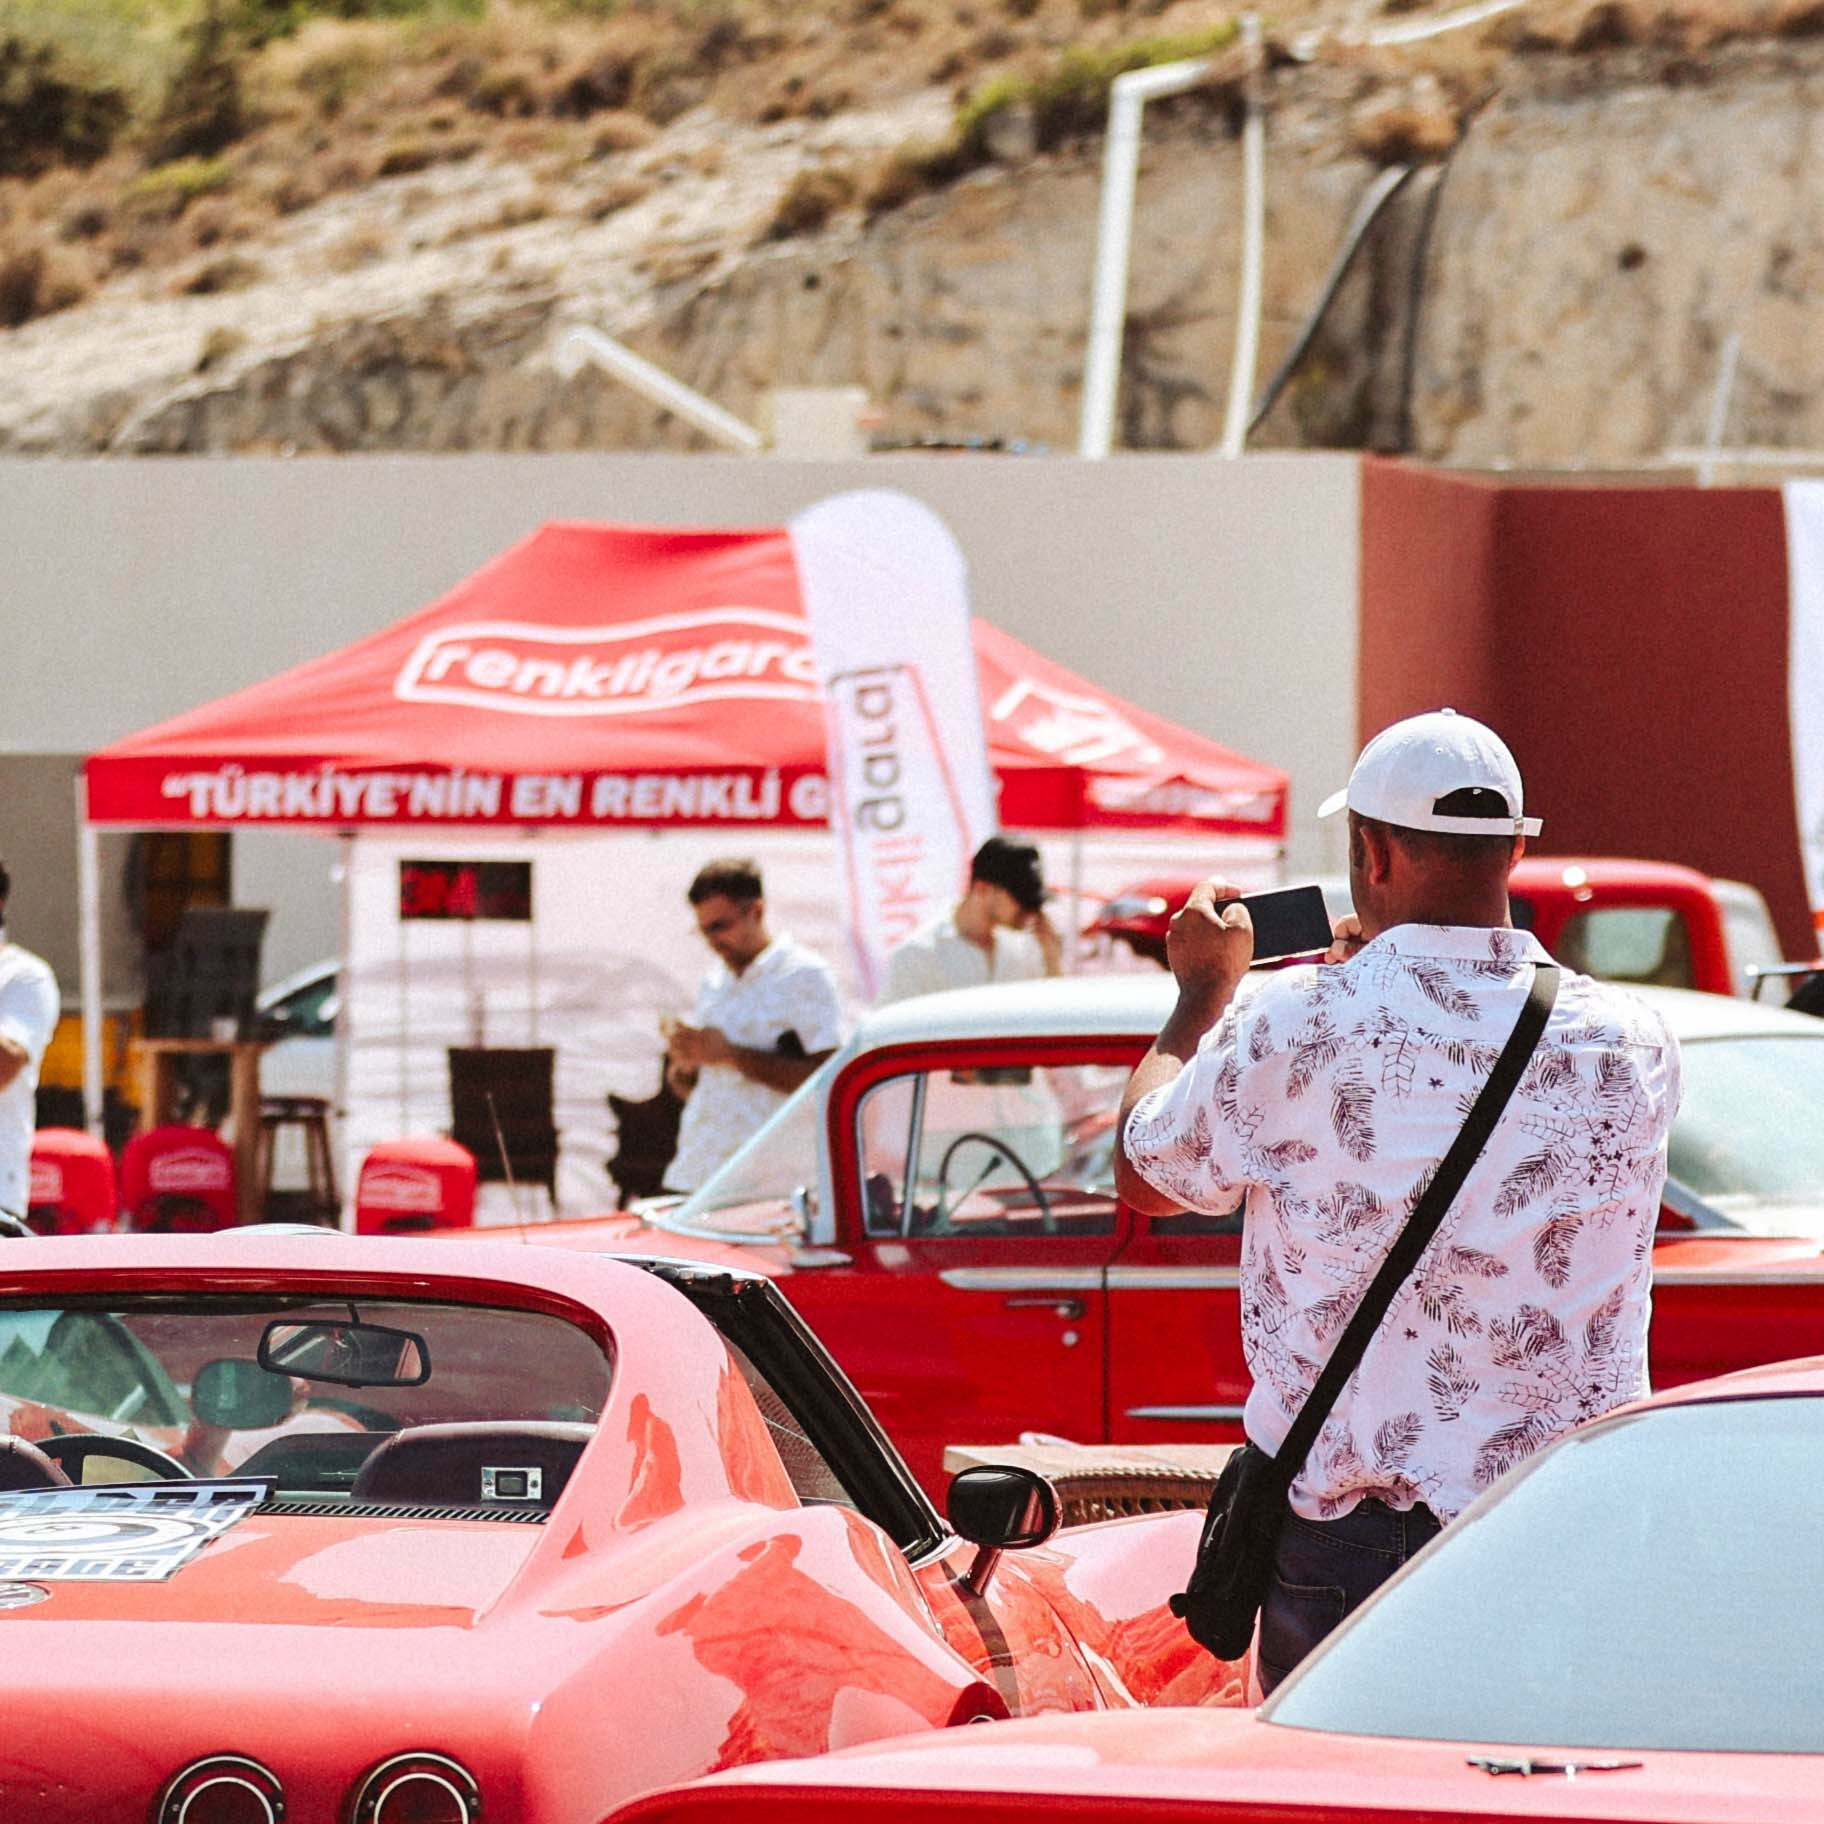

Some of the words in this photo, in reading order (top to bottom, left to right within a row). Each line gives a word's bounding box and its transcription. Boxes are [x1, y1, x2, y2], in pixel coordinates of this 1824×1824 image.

[427, 634, 817, 700] renkligara
[510, 775, 583, 818] EN
[591, 768, 781, 819] RENKLİ
